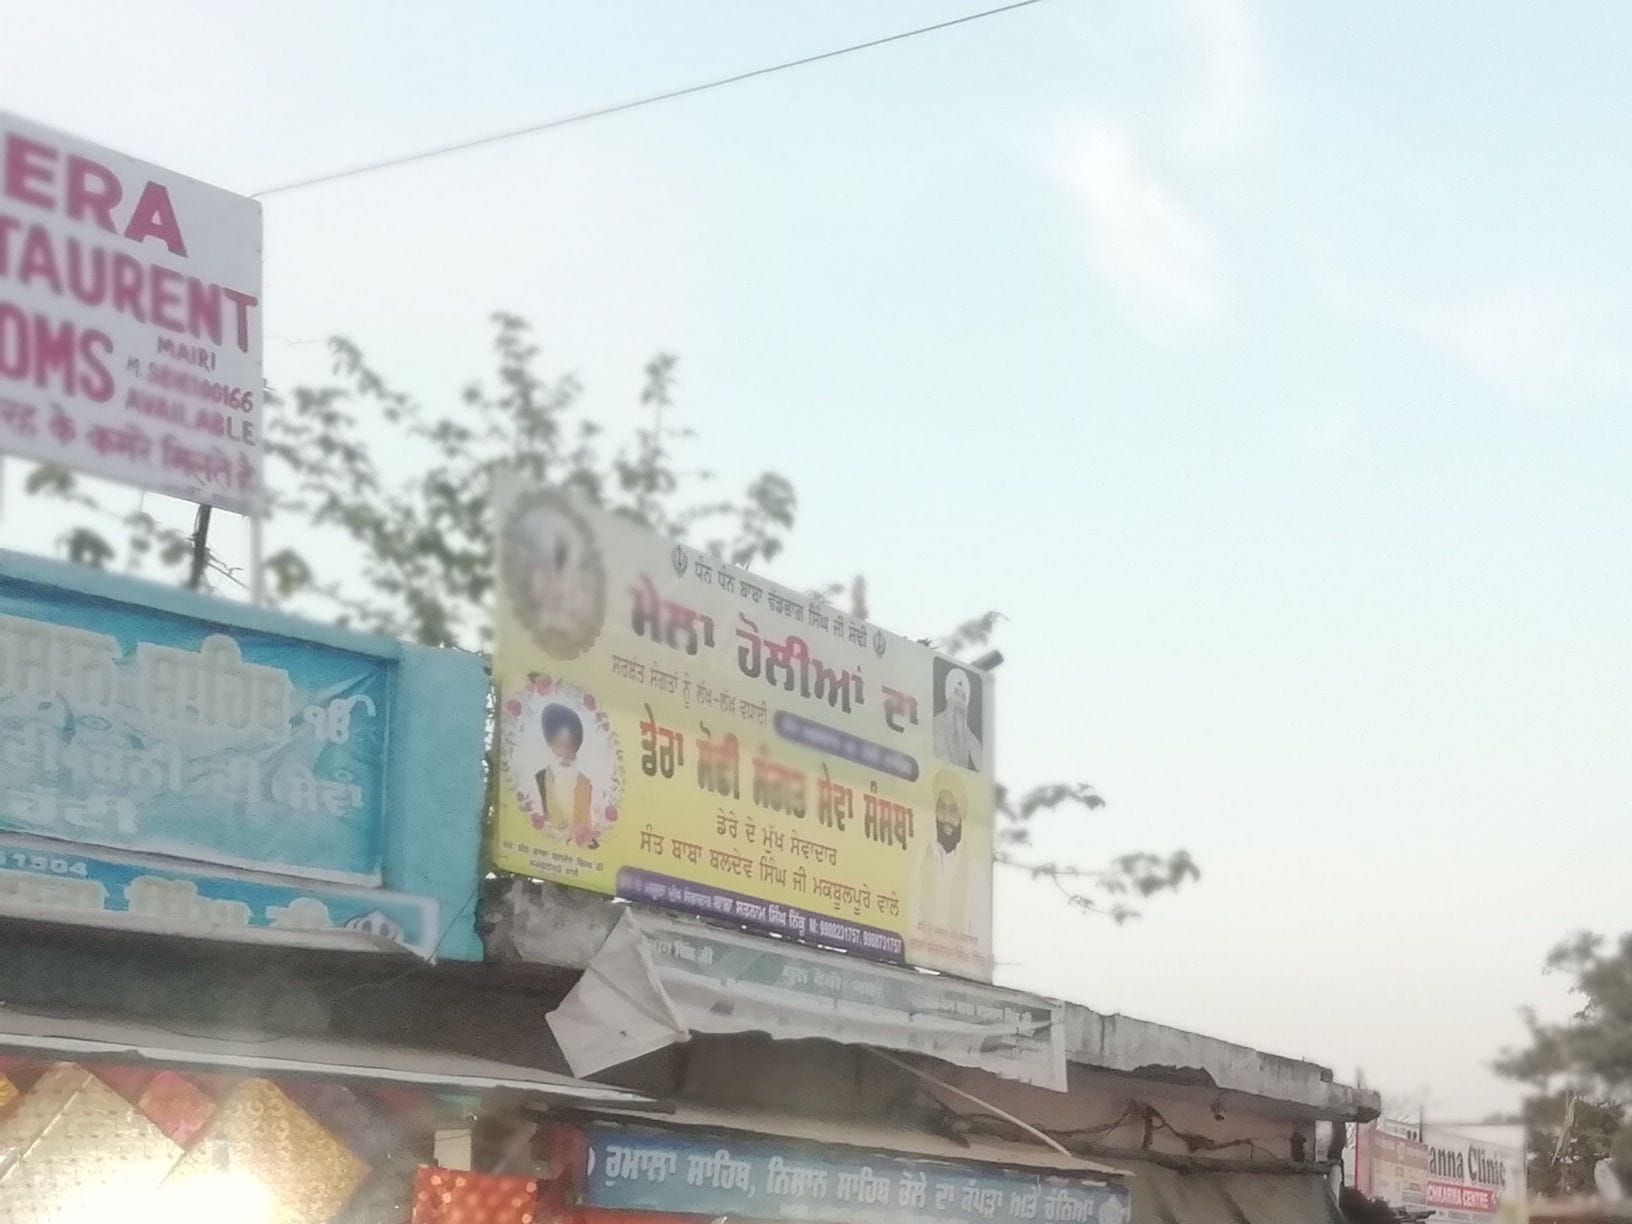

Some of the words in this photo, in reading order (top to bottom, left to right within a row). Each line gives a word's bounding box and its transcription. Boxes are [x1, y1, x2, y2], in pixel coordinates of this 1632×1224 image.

[157, 335, 216, 373] MAIRI
[736, 611, 865, 714] ਹੋਲੀਆਂ
[881, 685, 918, 734] ਦਾ
[639, 702, 685, 780] ਡੇਰਾ
[640, 823, 665, 856] ਸੰਤ
[671, 839, 703, 866] ਬਾਬਾ
[709, 846, 754, 878] ਬਲਦੇਵ
[759, 855, 788, 887] ਸਿੰਘ
[793, 865, 807, 893] ਜੀ
[876, 890, 900, 918] ਵਾਲੇ
[716, 807, 738, 839] ਡੇਰੇ
[745, 815, 756, 844] ਦੇ
[790, 829, 838, 867] ਸੇਵਾਦਾਰ
[837, 1166, 890, 1206] ਸਾਹਿਬ
